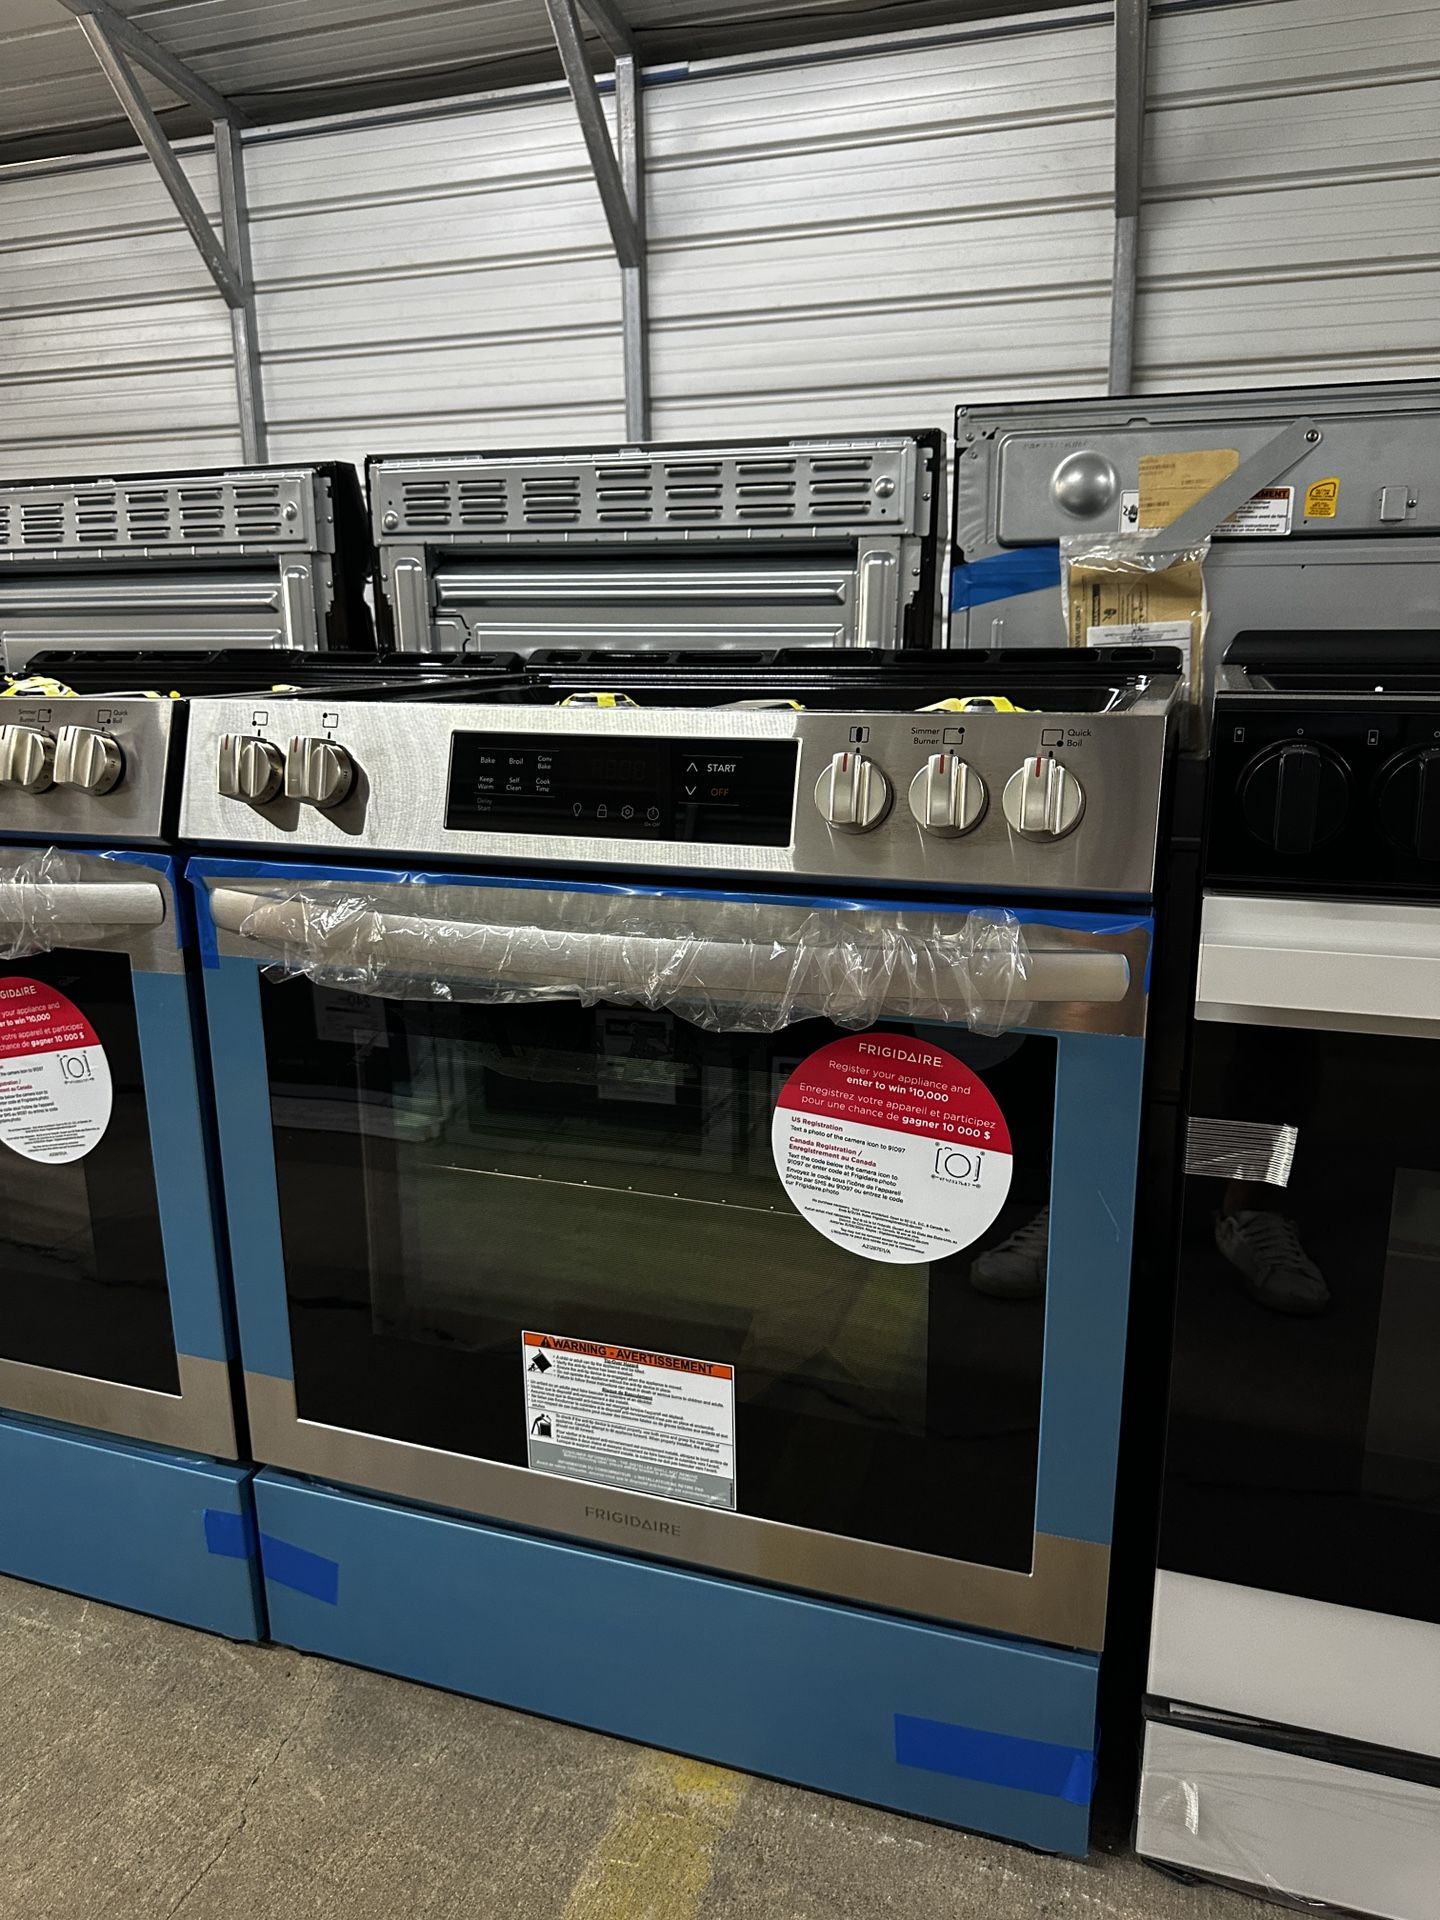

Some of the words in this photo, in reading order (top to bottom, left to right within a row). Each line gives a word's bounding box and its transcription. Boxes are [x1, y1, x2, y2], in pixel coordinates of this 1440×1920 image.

[1067, 729, 1092, 737] Quick
[1067, 739, 1082, 747] Boil
[480, 756, 496, 764] Bake
[508, 757, 524, 765] Broil
[706, 763, 736, 773] START
[480, 776, 494, 784] Keep
[509, 776, 520, 784] Self
[535, 777, 551, 785] Cook
[710, 787, 729, 797] OFF
[6, 1018, 14, 1026] to
[14, 1016, 26, 1025] win
[31, 1037, 54, 1047] gagner
[54, 1034, 63, 1042] 10
[63, 1032, 78, 1041] 000
[79, 1032, 84, 1040] $
[858, 1043, 942, 1067] FRIGIDAIRE
[829, 1060, 870, 1075] Register
[872, 1070, 896, 1080] your
[898, 1075, 948, 1091] appliance
[950, 1085, 971, 1095] and
[847, 1076, 873, 1088] enter
[875, 1081, 886, 1090] to
[888, 1084, 906, 1095] win
[909, 1087, 949, 1102] $10,000
[800, 1082, 855, 1101] Enregistrez
[858, 1095, 884, 1107] votre
[886, 1099, 927, 1115] appareil
[930, 1109, 940, 1118] et
[943, 1112, 996, 1129] participez
[791, 1116, 801, 1124] US
[802, 1118, 844, 1133] Registration
[801, 1095, 825, 1107] pour
[827, 1101, 846, 1110] une
[848, 1105, 884, 1119] chance
[886, 1111, 899, 1121] de
[902, 1115, 940, 1129] gagner
[942, 1122, 954, 1132] 10
[957, 1126, 981, 1138] 000
[983, 1130, 991, 1141] $
[789, 1136, 815, 1146] Canada
[816, 1142, 857, 1156] Registration
[808, 1129, 826, 1138] photo
[844, 1136, 866, 1146] camera
[866, 1140, 880, 1149] icon
[788, 1143, 840, 1161] Enregistrement
[850, 1156, 877, 1168] Canada
[786, 1166, 810, 1177] Envoyez
[816, 1173, 831, 1182] code
[832, 1176, 846, 1184] sous
[788, 1152, 800, 1160] Text
[811, 1156, 826, 1164] code
[826, 1159, 844, 1168] below
[844, 1163, 855, 1171] the
[856, 1166, 877, 1176] camera
[878, 1172, 891, 1180] icon
[891, 1174, 899, 1182] to
[812, 1164, 828, 1172] enter
[828, 1167, 843, 1176] code
[786, 1173, 802, 1182] photo
[803, 1177, 813, 1185] par
[814, 1178, 827, 1187] SMS
[862, 1189, 882, 1199] entrez
[888, 1195, 904, 1204] code
[553, 1338, 607, 1356] WARNING
[616, 1348, 713, 1374] AVERTISSEMENT
[585, 1506, 680, 1536] FRIGIDAIRE
